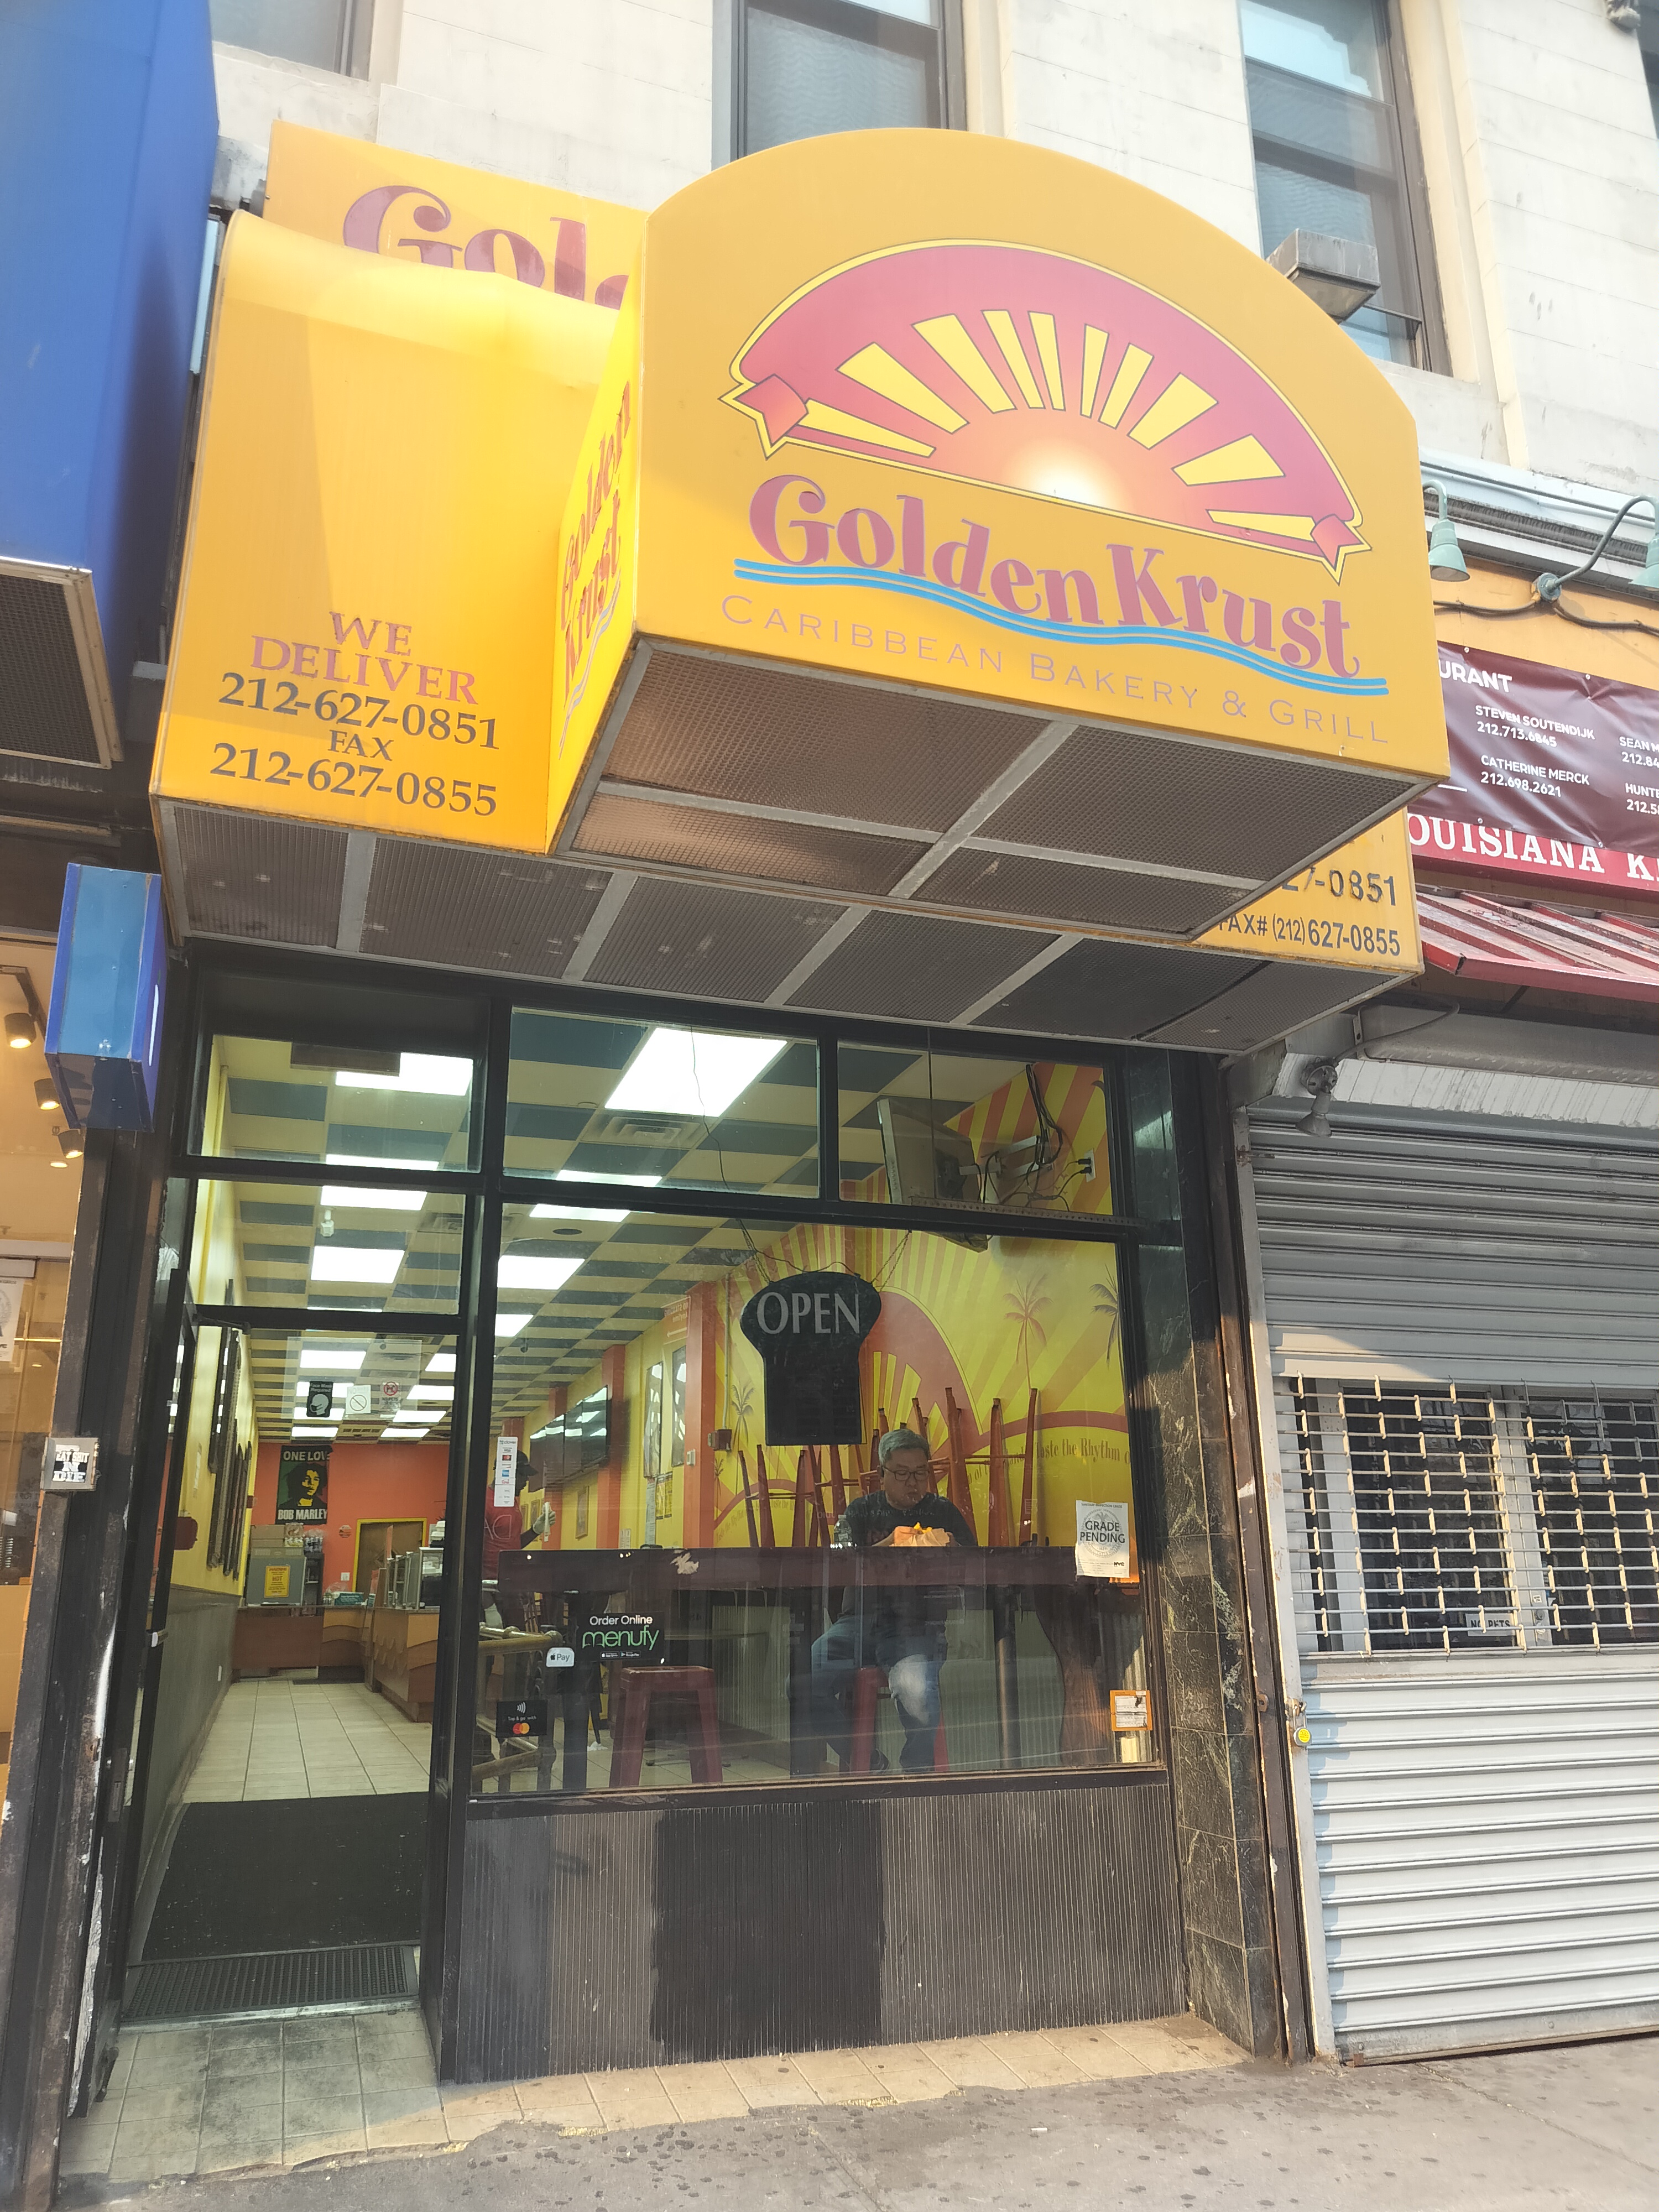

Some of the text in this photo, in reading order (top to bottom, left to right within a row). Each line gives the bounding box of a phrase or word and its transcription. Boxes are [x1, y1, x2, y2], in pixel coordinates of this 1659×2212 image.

[328, 611, 412, 657] WE
[250, 634, 478, 705] DELIVER
[721, 594, 1389, 744] CARIBBEAN BAKERY & GRILL
[1438, 659, 1512, 693] URANT
[218, 671, 500, 750] 212-627-0851
[1475, 705, 1596, 740] STEVEN SOUTENDIJK
[328, 728, 394, 761] FAX
[1477, 721, 1557, 748] 212.713.6845
[1619, 736, 1650, 751] SEAN
[210, 742, 497, 816] 212-627-0855
[1480, 755, 1590, 785] CATHERINE MERCK
[1480, 771, 1562, 797] 212.698.2621
[1626, 799, 1659, 815] 212.5
[756, 1291, 860, 1335] OPEN
[283, 1451, 306, 1461] ONE
[1062, 1438, 1077, 1456] the
[1079, 1437, 1120, 1463] Rhythm
[52, 1470, 86, 1483] DIE
[278, 1508, 327, 1520] BOB MARLEY
[1084, 1520, 1120, 1532] GRADE
[1079, 1531, 1125, 1543] PENDING
[589, 1614, 653, 1626] Order Online
[582, 1625, 660, 1651] menufy
